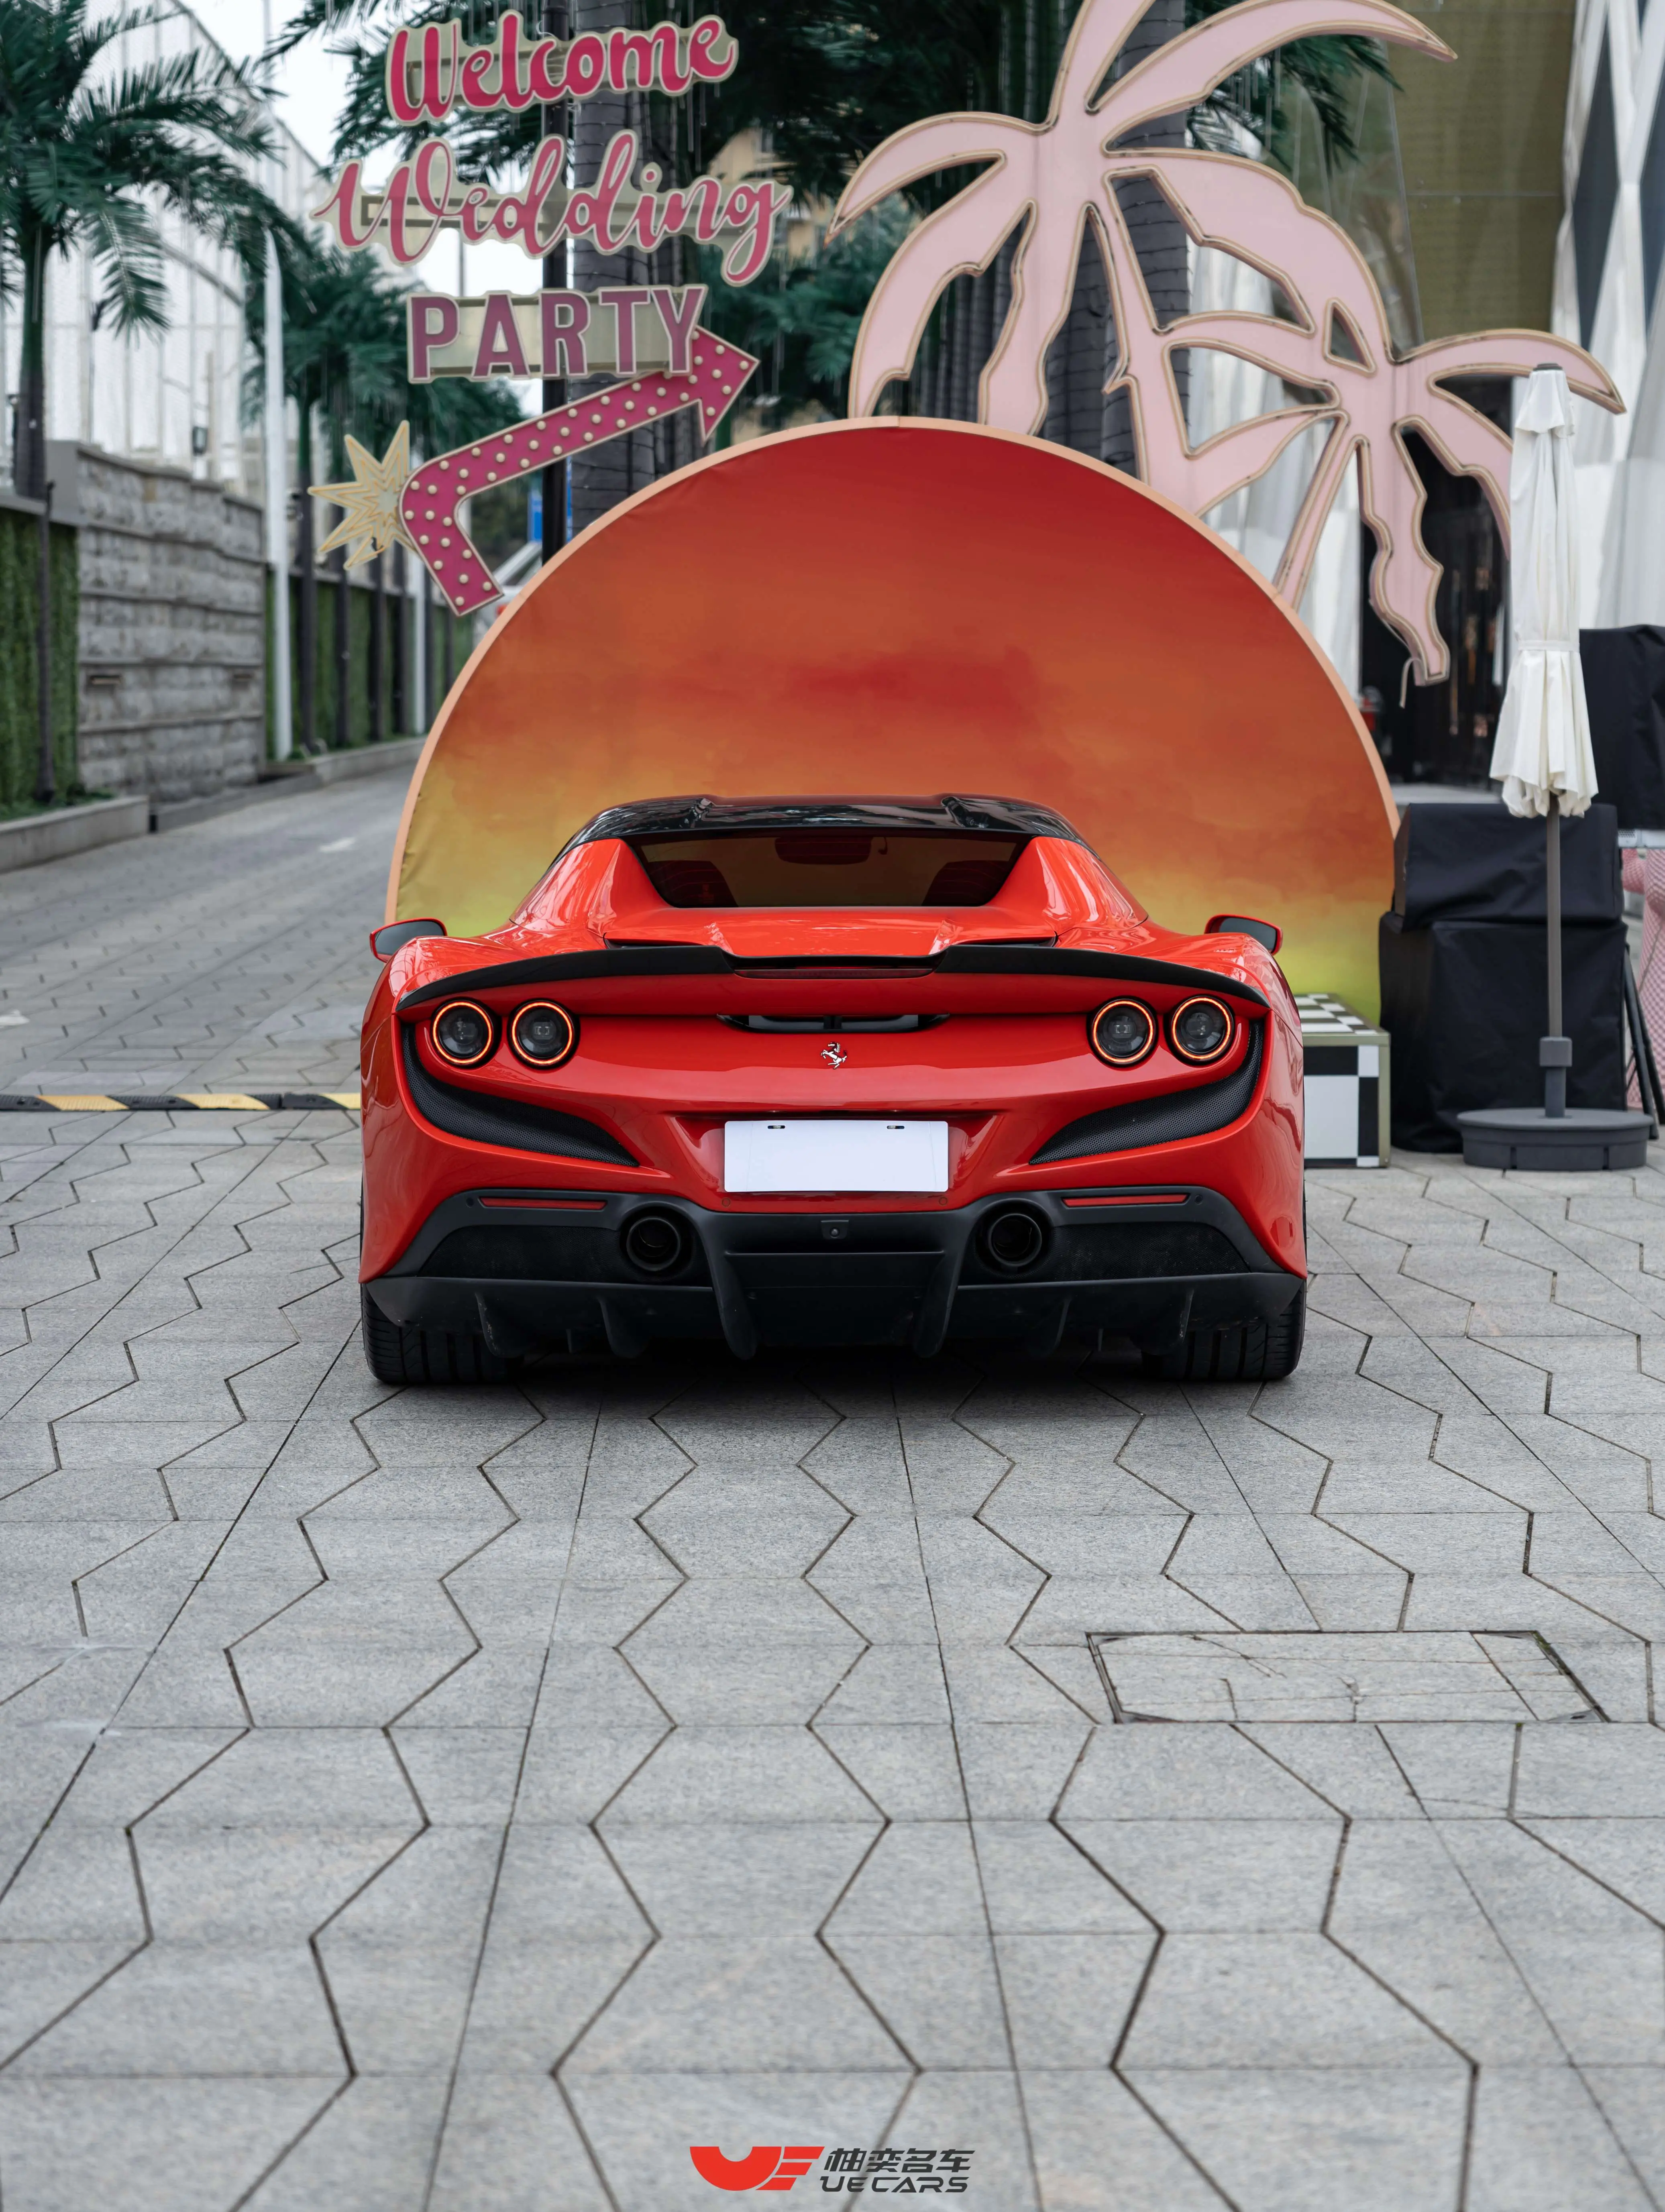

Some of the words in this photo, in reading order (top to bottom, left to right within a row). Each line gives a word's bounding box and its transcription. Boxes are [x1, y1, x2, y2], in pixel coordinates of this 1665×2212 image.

[388, 12, 738, 122] Welcome
[314, 132, 793, 283] Wedding
[410, 286, 707, 379] PARTY
